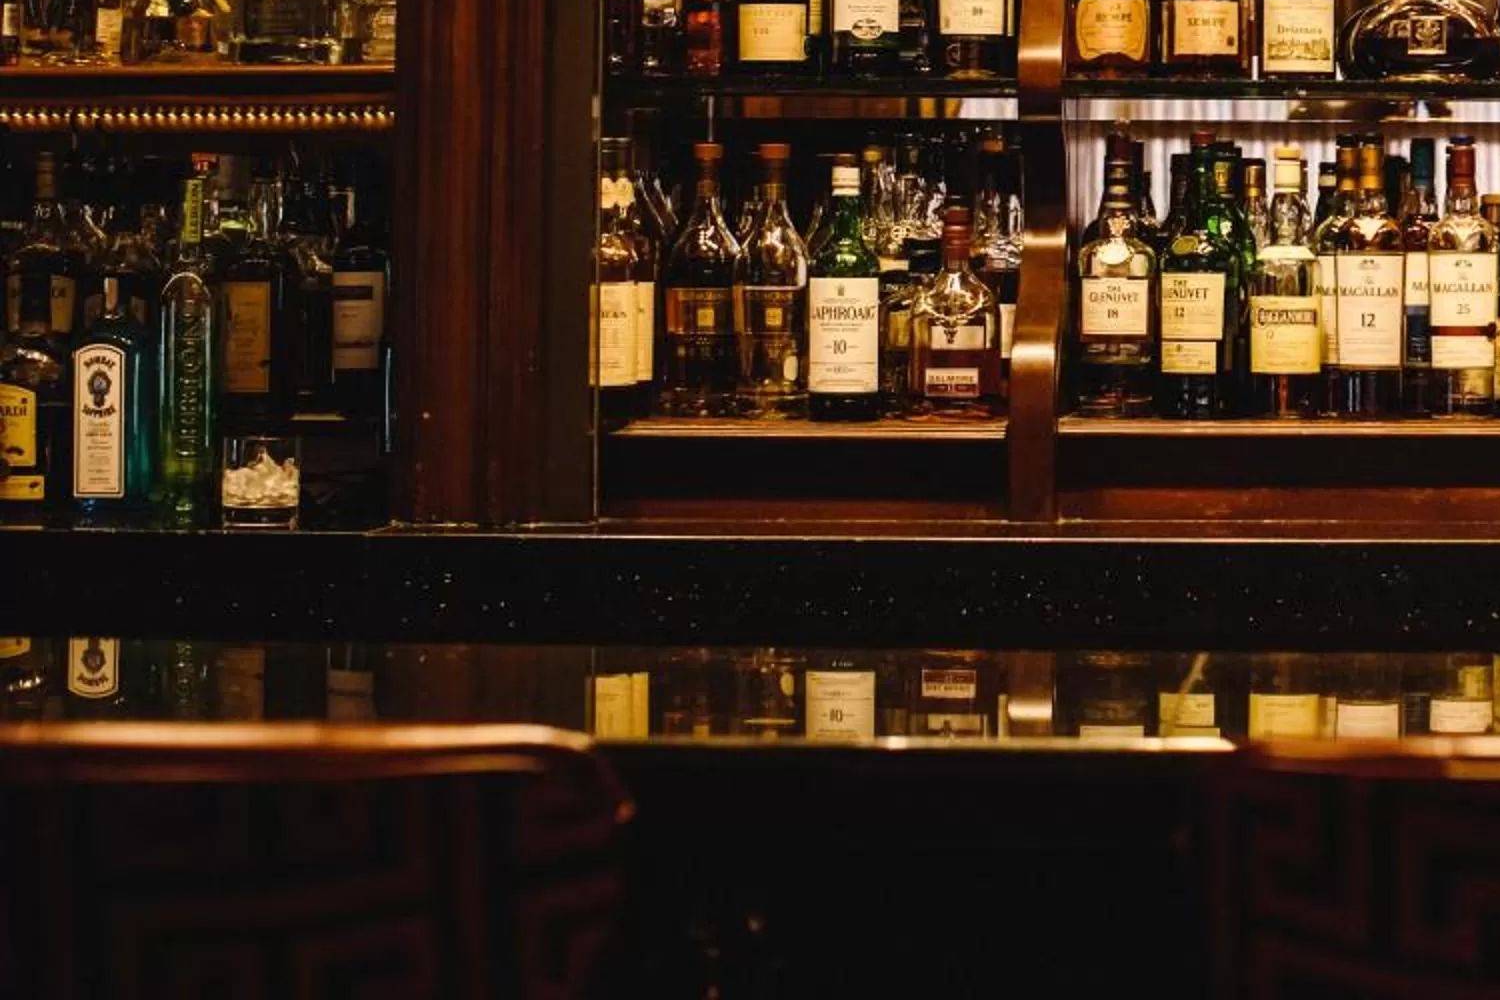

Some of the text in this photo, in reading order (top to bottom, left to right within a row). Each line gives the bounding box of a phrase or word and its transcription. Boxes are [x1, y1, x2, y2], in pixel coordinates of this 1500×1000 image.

[1339, 285, 1400, 297] MACALLAN
[1432, 281, 1493, 293] MACALLAN
[1088, 291, 1140, 303] GLENLIVET
[1106, 308, 1119, 320] 18
[1360, 312, 1377, 328] 12
[832, 339, 848, 355] 10
[83, 355, 117, 369] BOMBAY
